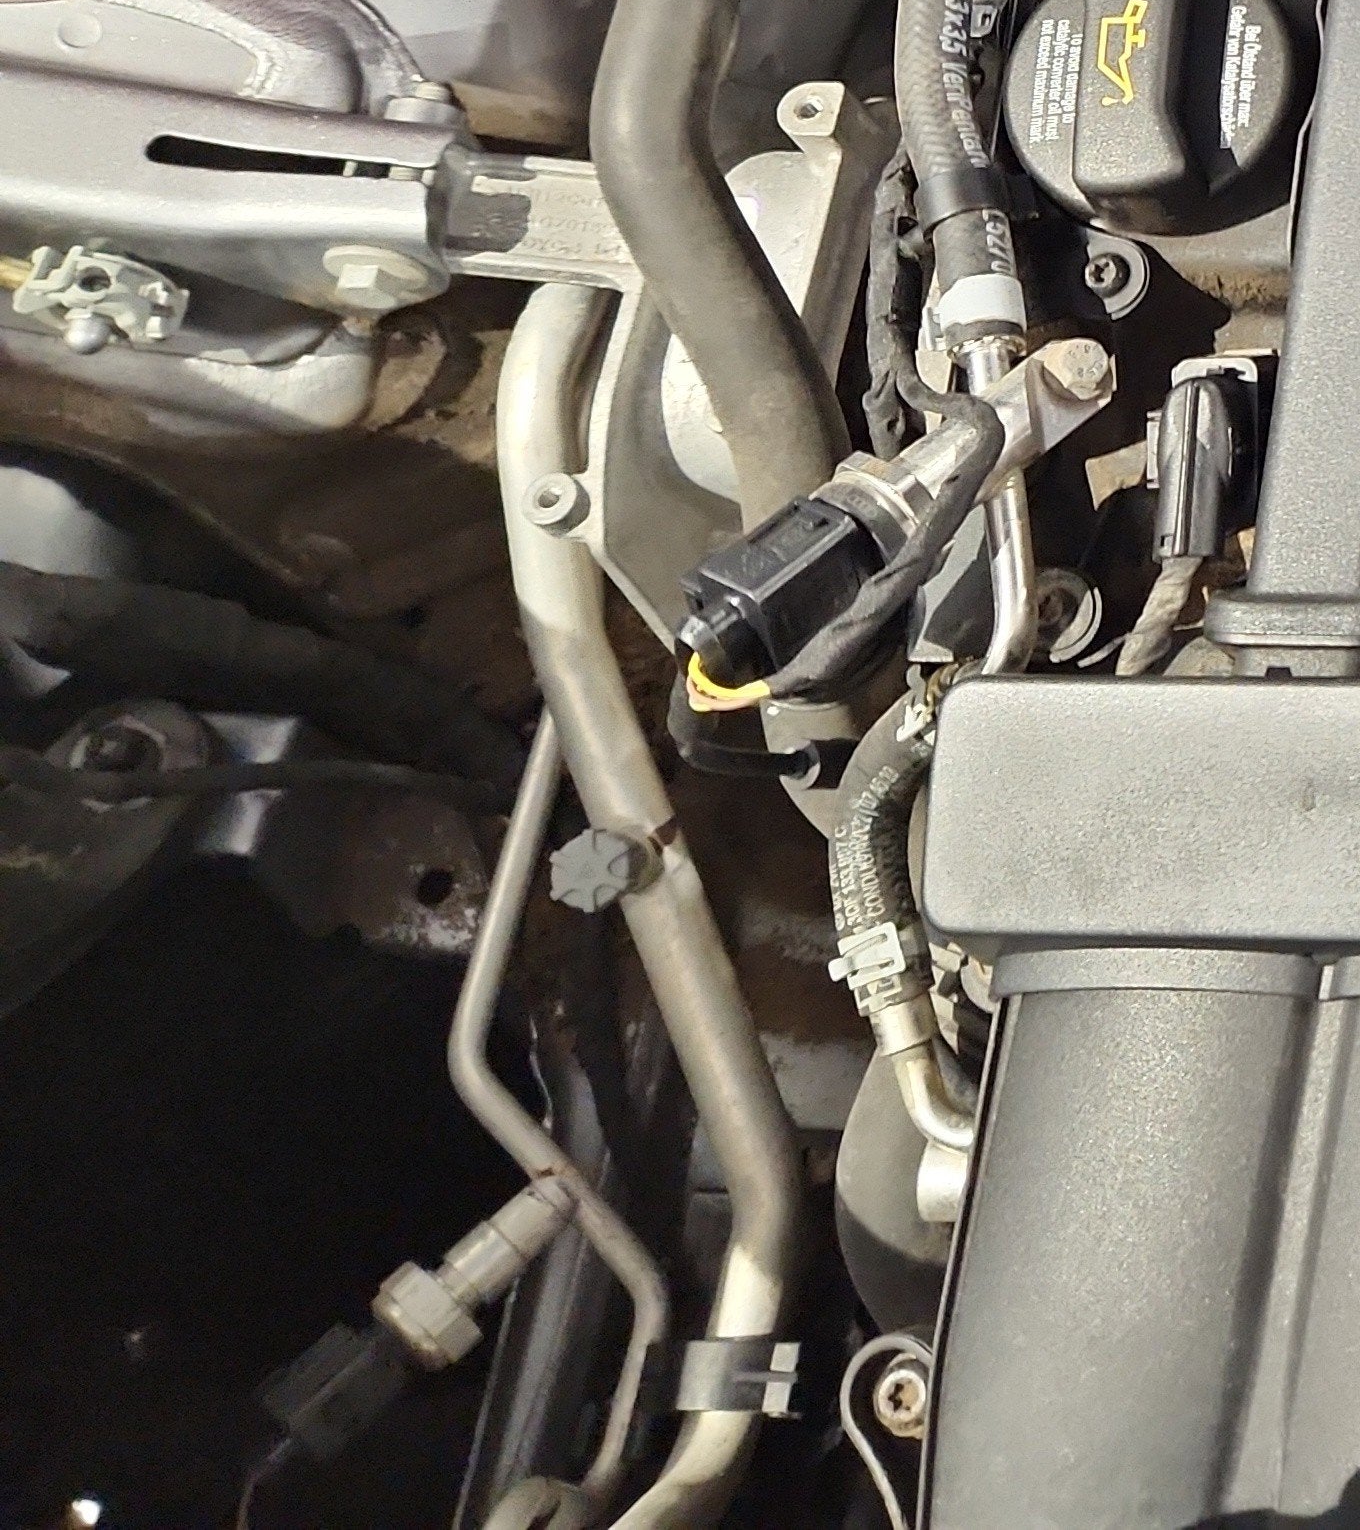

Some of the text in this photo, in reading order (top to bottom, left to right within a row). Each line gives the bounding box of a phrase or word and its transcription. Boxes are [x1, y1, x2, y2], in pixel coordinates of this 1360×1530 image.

[1040, 19, 1054, 34] not
[1053, 19, 1069, 56] catalytic
[1229, 5, 1246, 37] Gefahr
[1244, 24, 1261, 41] Bei
[1036, 36, 1050, 69] exceed
[1225, 38, 1239, 55] von
[1241, 42, 1261, 78] Ölstand
[1032, 70, 1047, 116] maximum
[1048, 57, 1064, 101] converter
[1061, 33, 1082, 123] To avoid damage to
[1239, 79, 1255, 102] über
[1047, 102, 1061, 114] oil
[980, 205, 1016, 276] L5270
